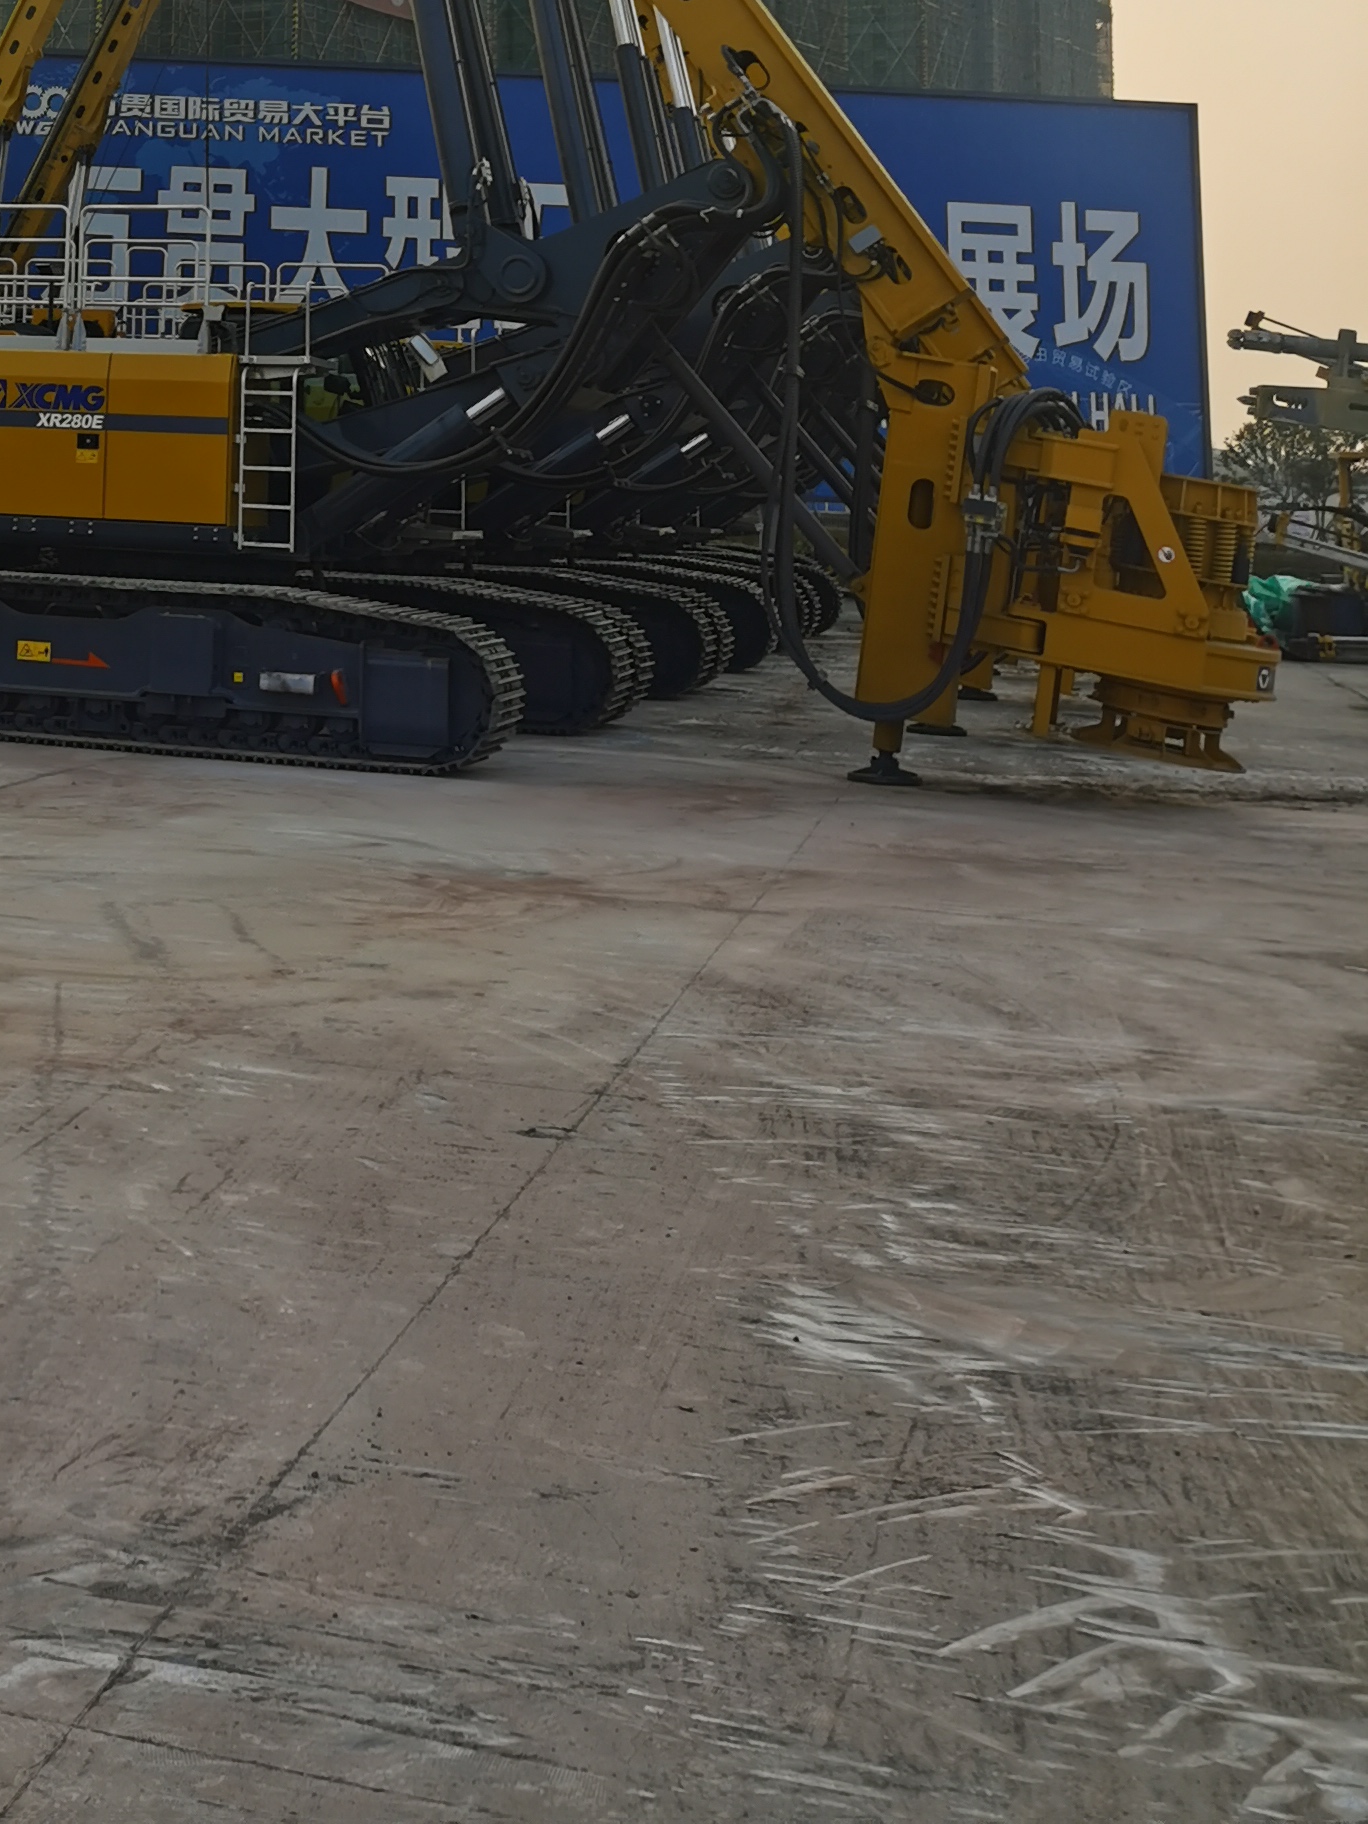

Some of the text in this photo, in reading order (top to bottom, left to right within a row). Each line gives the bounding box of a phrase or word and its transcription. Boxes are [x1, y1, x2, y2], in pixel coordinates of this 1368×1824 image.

[258, 126, 391, 148] MARKET
[947, 201, 1149, 363] 展场
[8, 382, 105, 412] XCMG
[36, 412, 105, 430] XR280E
